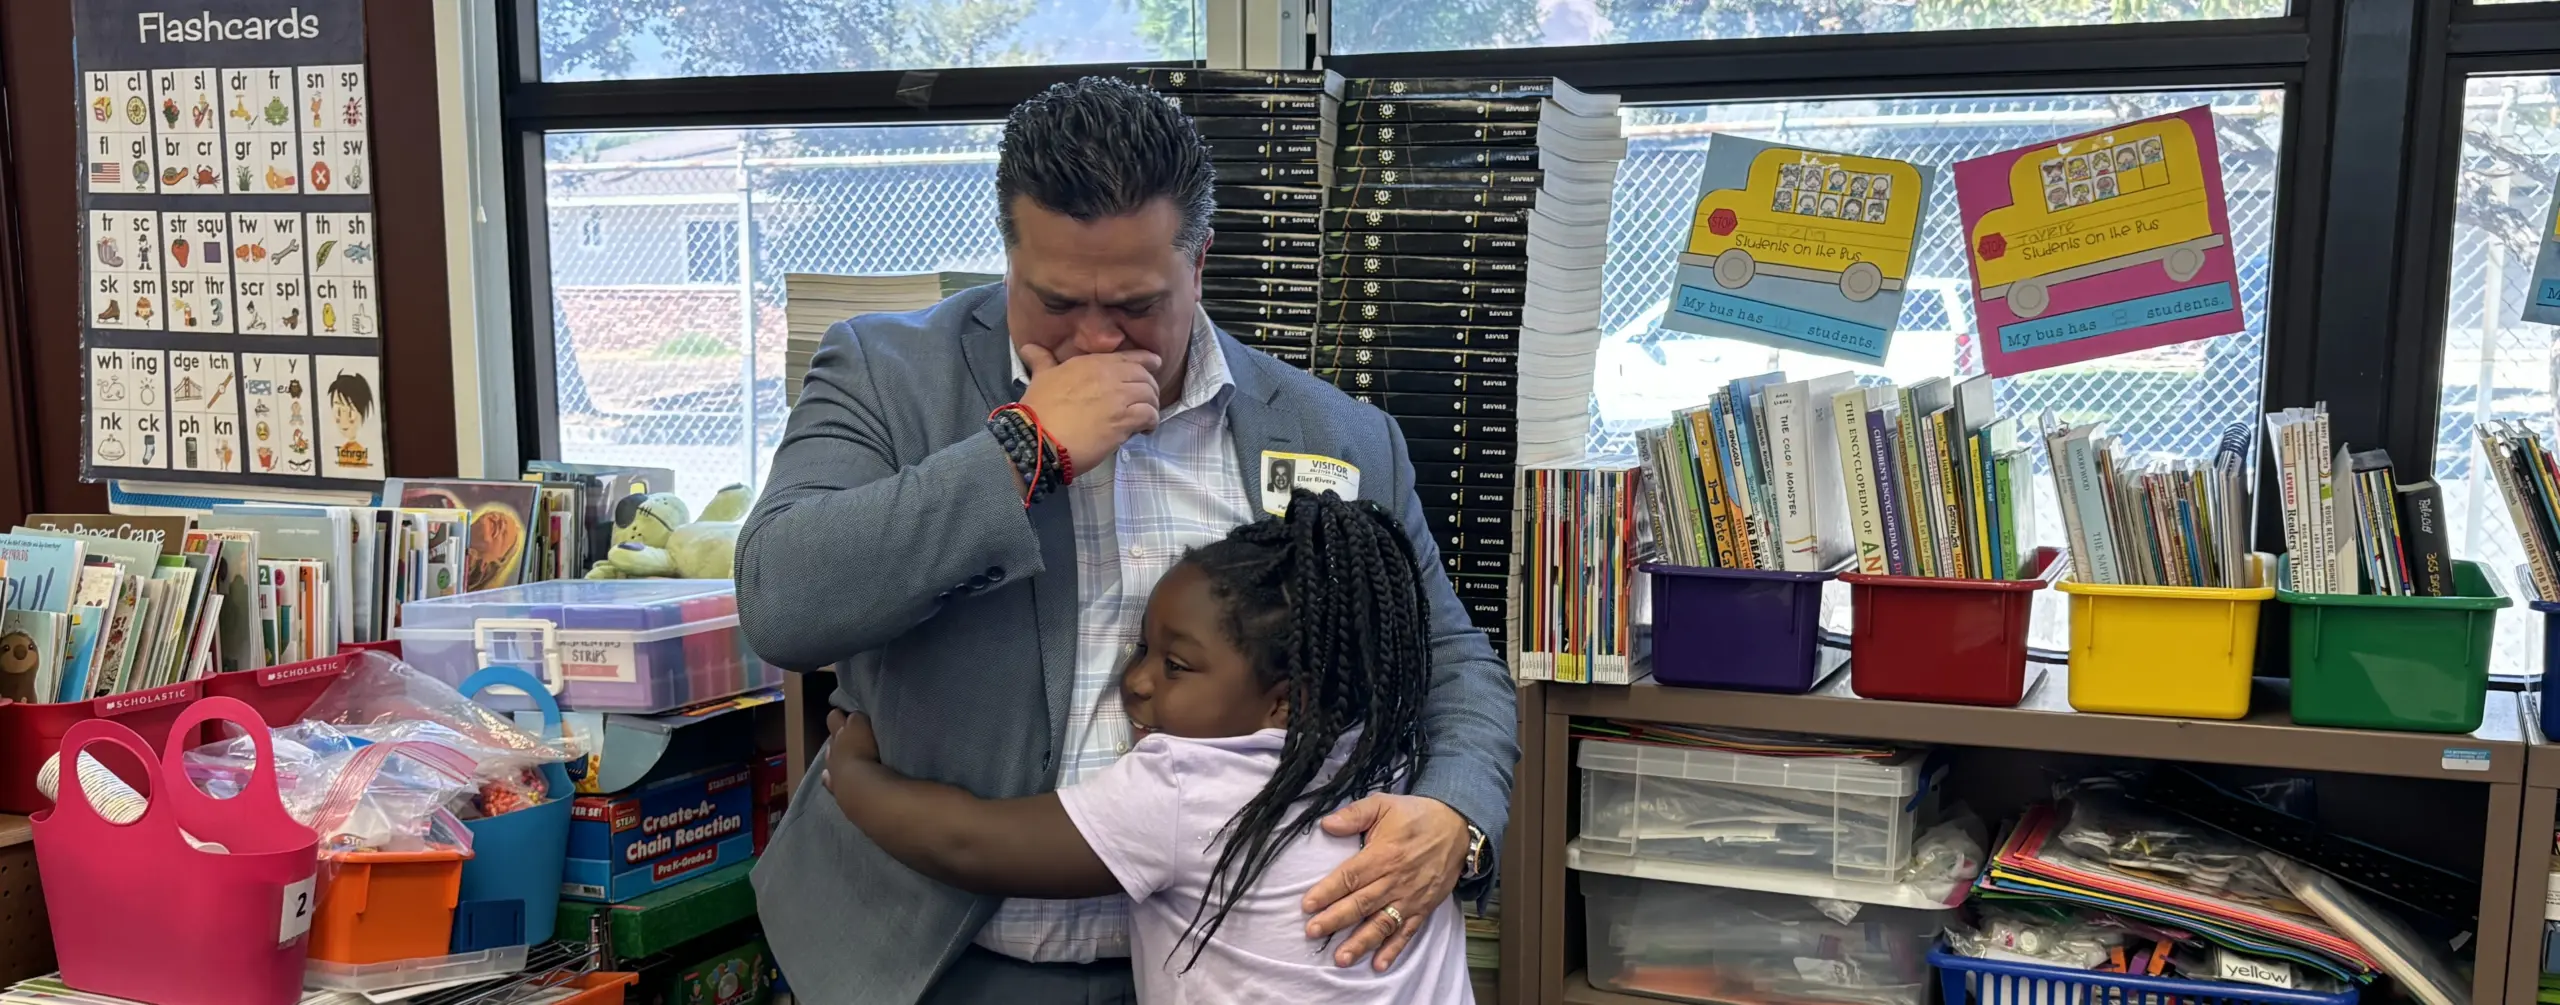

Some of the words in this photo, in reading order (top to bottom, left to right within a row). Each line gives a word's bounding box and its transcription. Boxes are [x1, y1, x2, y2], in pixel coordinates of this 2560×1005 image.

[138, 7, 320, 44] Flashcards
[94, 74, 108, 91] bl
[128, 72, 141, 91] cl
[162, 72, 174, 95] pl
[195, 71, 205, 89] sl
[232, 71, 247, 90] dr
[269, 70, 280, 89] fr
[307, 74, 324, 88] sn
[342, 72, 358, 92] sp
[100, 136, 108, 154] fl
[132, 137, 145, 159] gl
[166, 138, 180, 156] br
[198, 142, 212, 155] cr
[236, 142, 251, 160] gr
[271, 142, 287, 159] pr
[313, 138, 325, 155] st
[344, 141, 362, 155] sw
[102, 213, 112, 231] tr
[134, 218, 149, 231] sc
[171, 215, 186, 232] str
[198, 220, 223, 237] squ
[239, 215, 257, 233] tw
[274, 220, 294, 233] wr
[316, 215, 330, 234] th
[349, 216, 364, 234] sh
[1735, 233, 1790, 254] Students
[1816, 243, 1836, 258] the
[1840, 249, 1863, 262] Bus
[2022, 237, 2080, 261] Students
[2110, 222, 2132, 240] the
[2135, 218, 2160, 234] Bus
[101, 275, 118, 293] sk
[134, 280, 155, 294] sm
[172, 280, 193, 297] spr
[205, 276, 224, 294] thr
[241, 282, 264, 295] scr
[277, 279, 299, 300] spl
[317, 280, 336, 298] ch
[353, 280, 367, 299] th
[1683, 295, 1704, 313] My
[1709, 301, 1734, 318] bus
[1737, 308, 1765, 324] has
[1807, 325, 1877, 350] students.
[2007, 331, 2031, 348] My
[2036, 325, 2064, 342] bus
[2068, 319, 2097, 336] has
[2146, 295, 2225, 320] students.
[97, 352, 122, 369] wh
[132, 352, 156, 375] ing
[174, 351, 201, 371] dge
[209, 352, 230, 369] tch
[254, 358, 261, 372] y
[289, 359, 296, 373] y
[101, 412, 121, 430] nk
[138, 414, 159, 431] ck
[1845, 401, 1855, 425] THE
[180, 416, 199, 438] ph
[214, 417, 232, 434] kn
[1780, 415, 1789, 434] THE
[1728, 430, 1741, 467] RINGGOLD
[1782, 437, 1793, 468] COLOR
[1312, 459, 1348, 476] VISITOR
[1849, 428, 1869, 517] ENCYCLOPEDIA
[1785, 471, 1797, 518] MONSTER
[1873, 427, 1887, 482] CHILDREN'S
[1882, 483, 1899, 549] ENCYCLOPEDIA
[1892, 549, 1900, 562] OF
[2286, 471, 2295, 505] LEVELED
[117, 523, 166, 544] Crane
[1713, 515, 1726, 541] Pete
[1745, 514, 1756, 539] TAR
[1863, 520, 1872, 535] OF
[2287, 508, 2300, 551] Readers'
[1921, 538, 1929, 554] Their
[2092, 531, 2102, 554] THE
[2326, 528, 2334, 556] REVERE,
[1924, 555, 1933, 575] Food?
[2427, 552, 2439, 572] 365
[2522, 532, 2540, 565] HOORAY
[2534, 565, 2547, 583] FOR
[260, 568, 267, 582] 2
[2327, 558, 2337, 592] ENGINEER
[276, 661, 339, 681] SCHOLASTIC
[116, 688, 186, 709] SCHOLASTIC
[615, 815, 637, 829] STEM
[642, 800, 717, 834] Create-A-
[626, 834, 672, 863] Chain
[674, 813, 742, 847] Reaction
[658, 863, 672, 876] Pre
[672, 852, 705, 873] K-Grade
[706, 849, 713, 860] 2
[296, 892, 307, 918] 2
[2226, 964, 2288, 984] yellow
